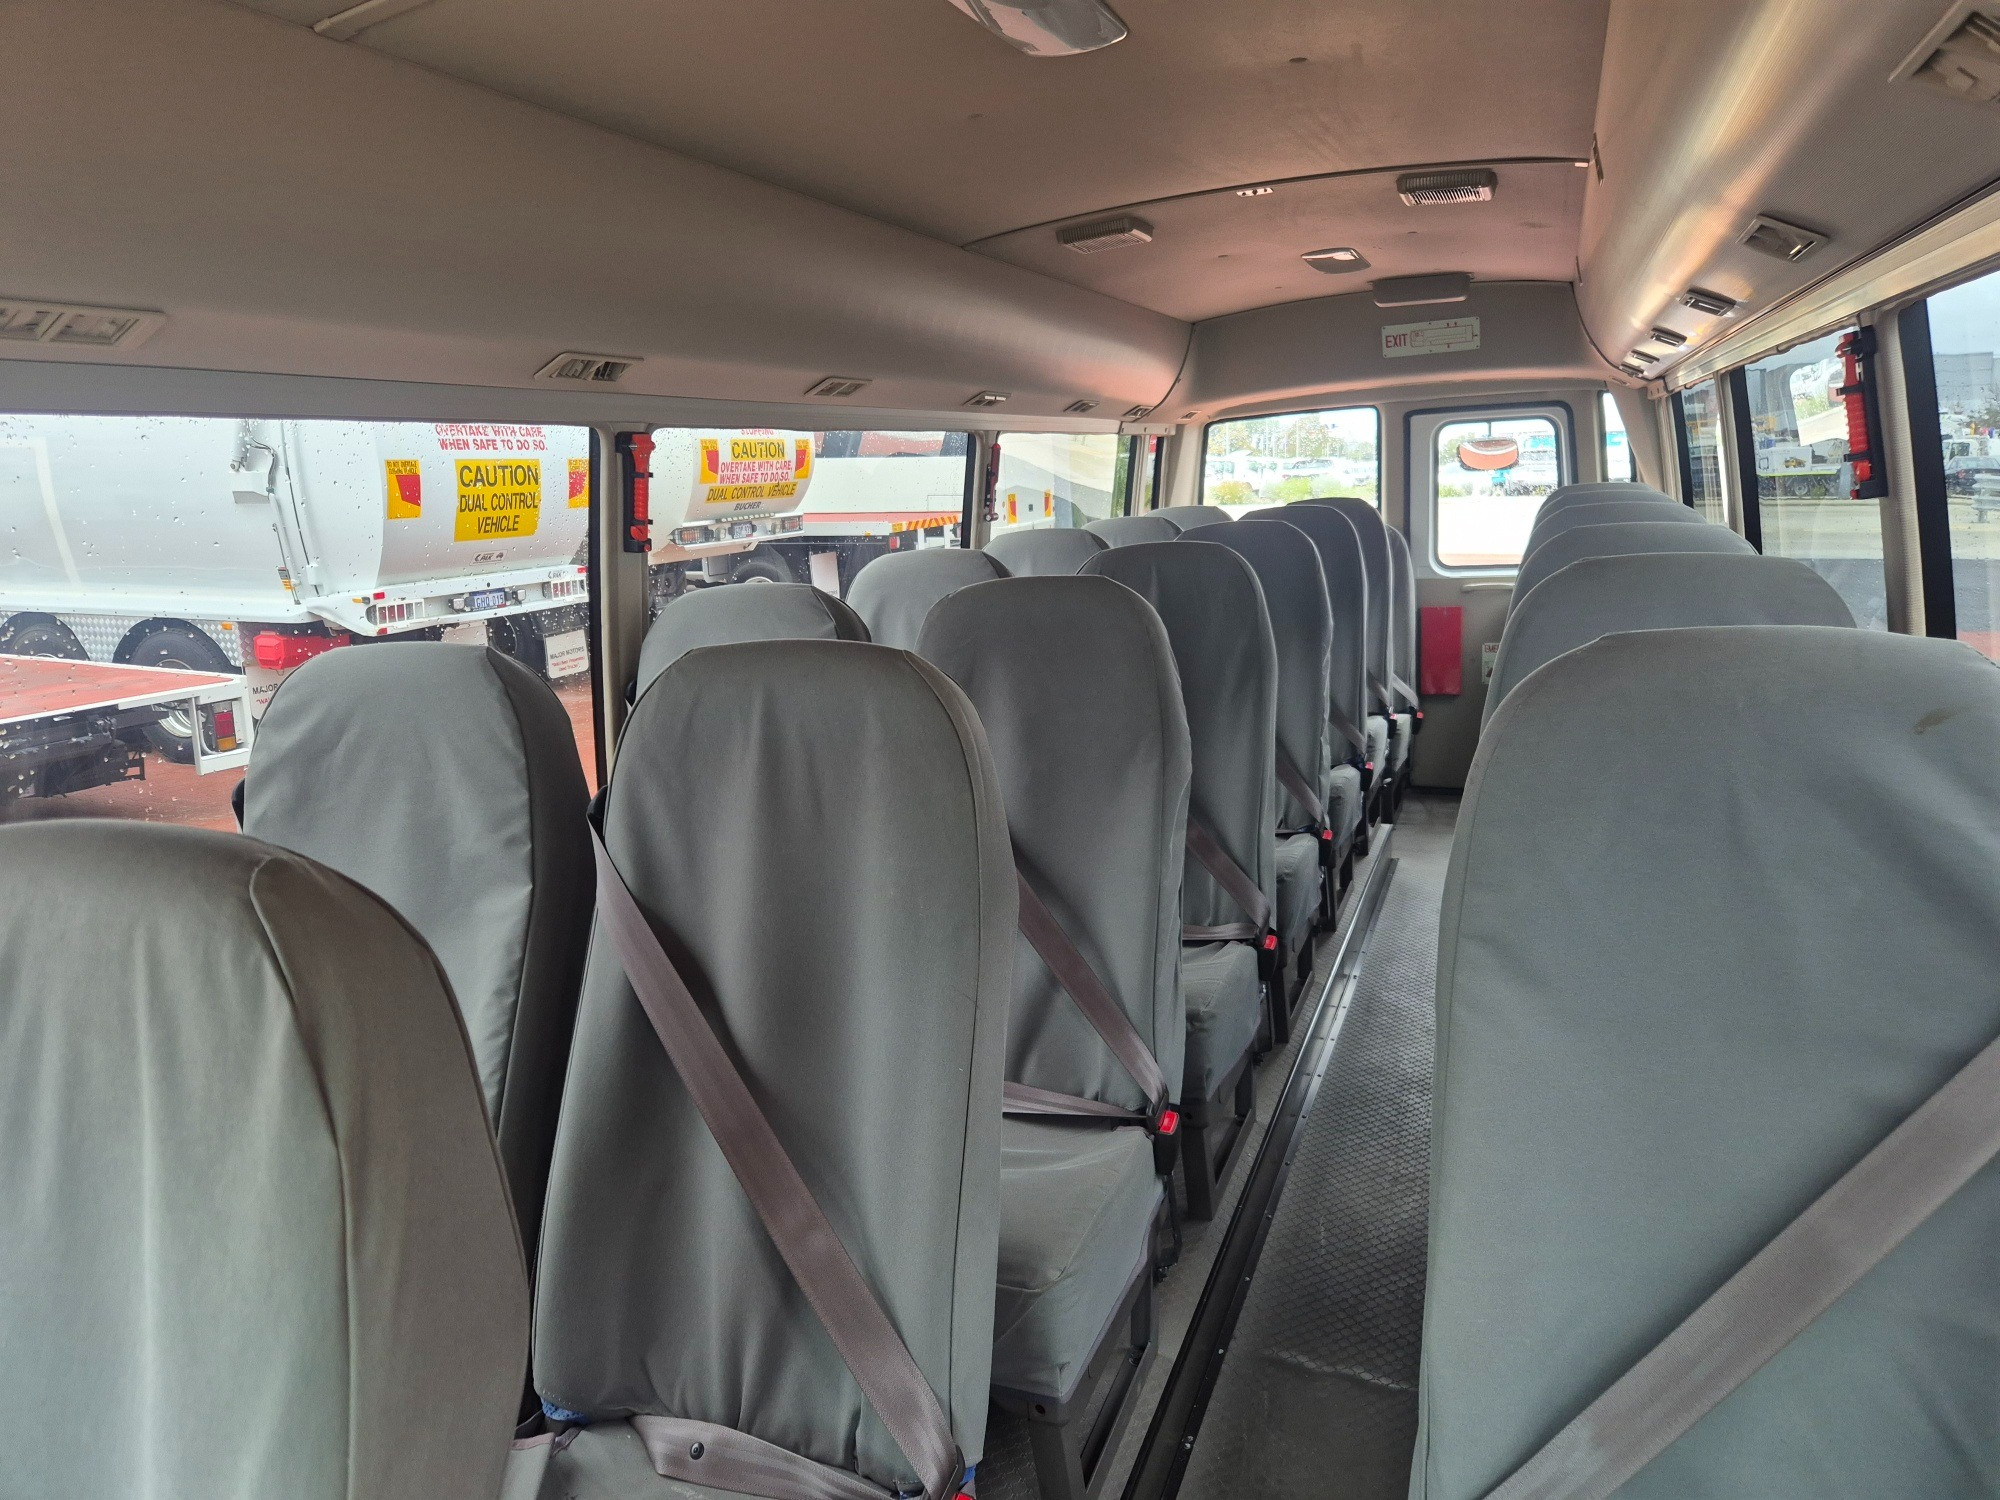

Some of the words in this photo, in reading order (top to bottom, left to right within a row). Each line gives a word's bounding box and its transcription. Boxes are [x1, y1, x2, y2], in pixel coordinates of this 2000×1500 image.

[1385, 333, 1408, 349] EXIT
[434, 424, 490, 437] OVERTAKE
[491, 425, 518, 437] WITH
[438, 438, 470, 451] WHEN
[472, 439, 499, 451] SAFE
[500, 439, 514, 451] TO
[516, 439, 531, 451] DO
[732, 442, 785, 459] CAUTION
[720, 461, 756, 474] OVERTAKE
[757, 461, 775, 472] WITH
[460, 465, 538, 487] CAUTION
[719, 473, 741, 485] WHEN
[742, 472, 759, 484] SAFE
[760, 472, 769, 483] TO
[769, 472, 779, 483] DO
[707, 488, 727, 501] DUAL
[731, 485, 765, 500] CONTROL
[768, 484, 796, 496] VEHICLE
[459, 493, 488, 513] DUAL
[490, 491, 539, 511] CONTROL
[733, 501, 762, 511] BUCHER
[478, 515, 519, 534] VEHICLE
[550, 651, 565, 659] MAJOR
[252, 683, 278, 695] MAJOR
